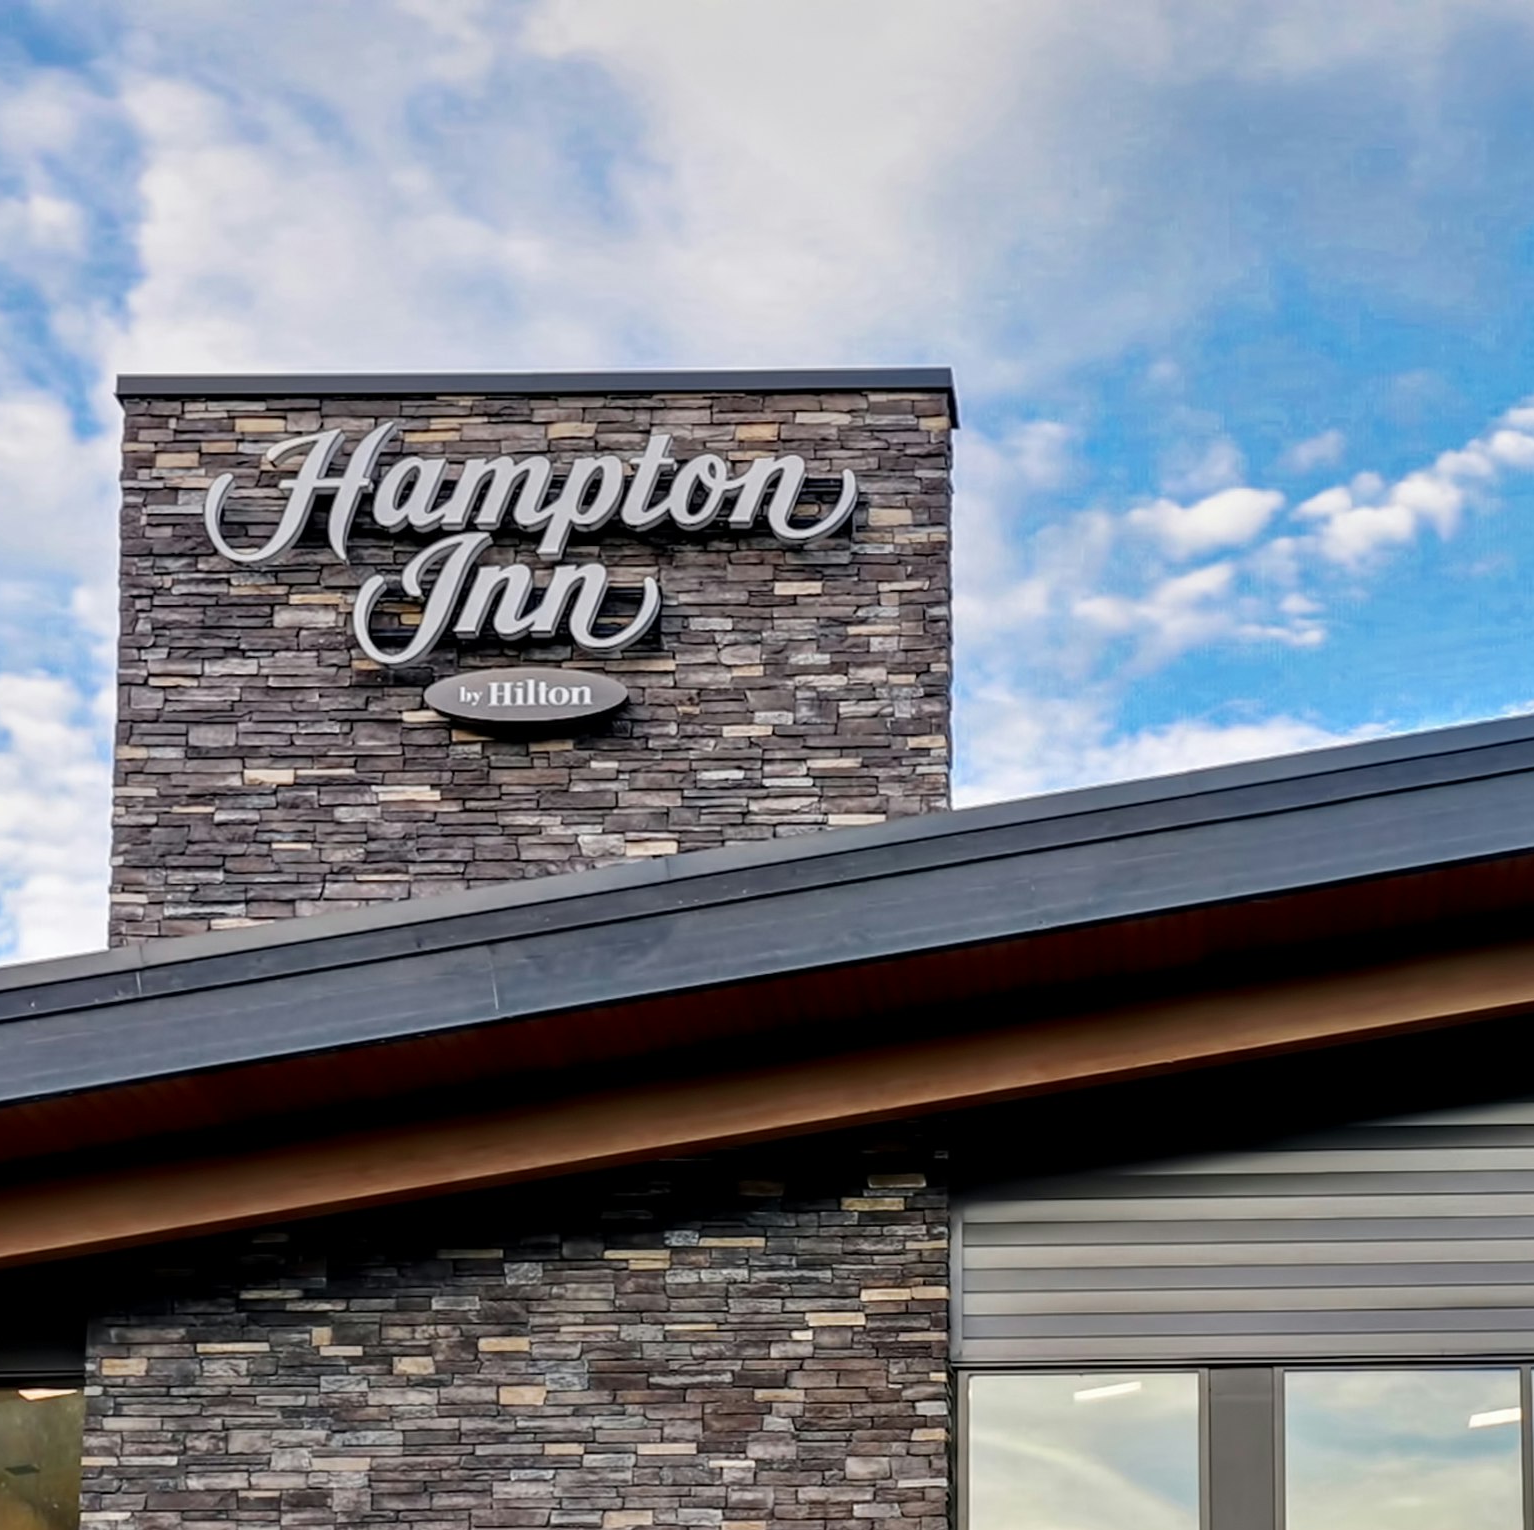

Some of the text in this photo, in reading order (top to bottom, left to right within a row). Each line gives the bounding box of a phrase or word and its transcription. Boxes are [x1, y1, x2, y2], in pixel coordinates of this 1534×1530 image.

[203, 420, 858, 564] Hampton
[353, 532, 662, 667] Inn
[459, 679, 593, 706] by Hilton
